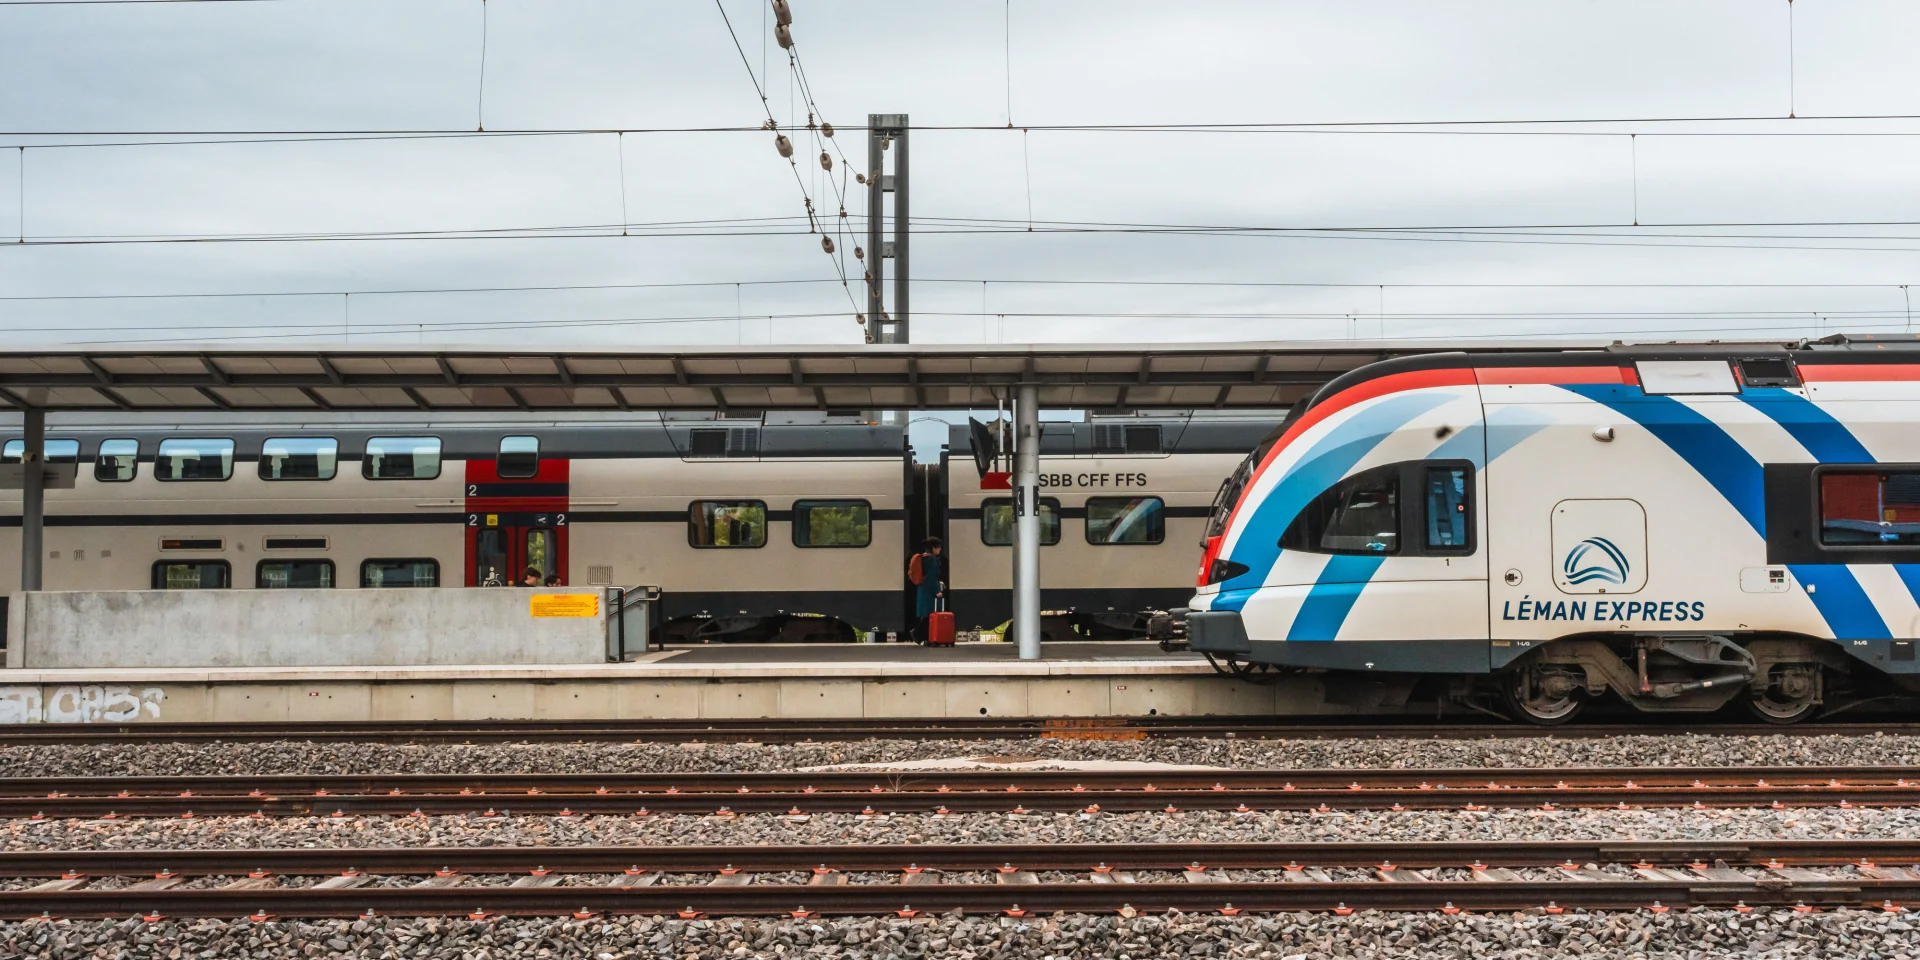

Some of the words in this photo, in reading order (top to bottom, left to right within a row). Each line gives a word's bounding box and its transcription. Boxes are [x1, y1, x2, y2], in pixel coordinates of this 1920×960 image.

[1038, 473, 1073, 487] SBB
[1077, 473, 1110, 487] CFF
[1115, 473, 1147, 487] FFS
[469, 484, 477, 496] 2
[469, 514, 478, 526] 2
[556, 514, 565, 526] 2
[1445, 558, 1450, 567] 1
[1502, 594, 1587, 621] LÉMAN
[1593, 601, 1705, 621] EXPRESS
